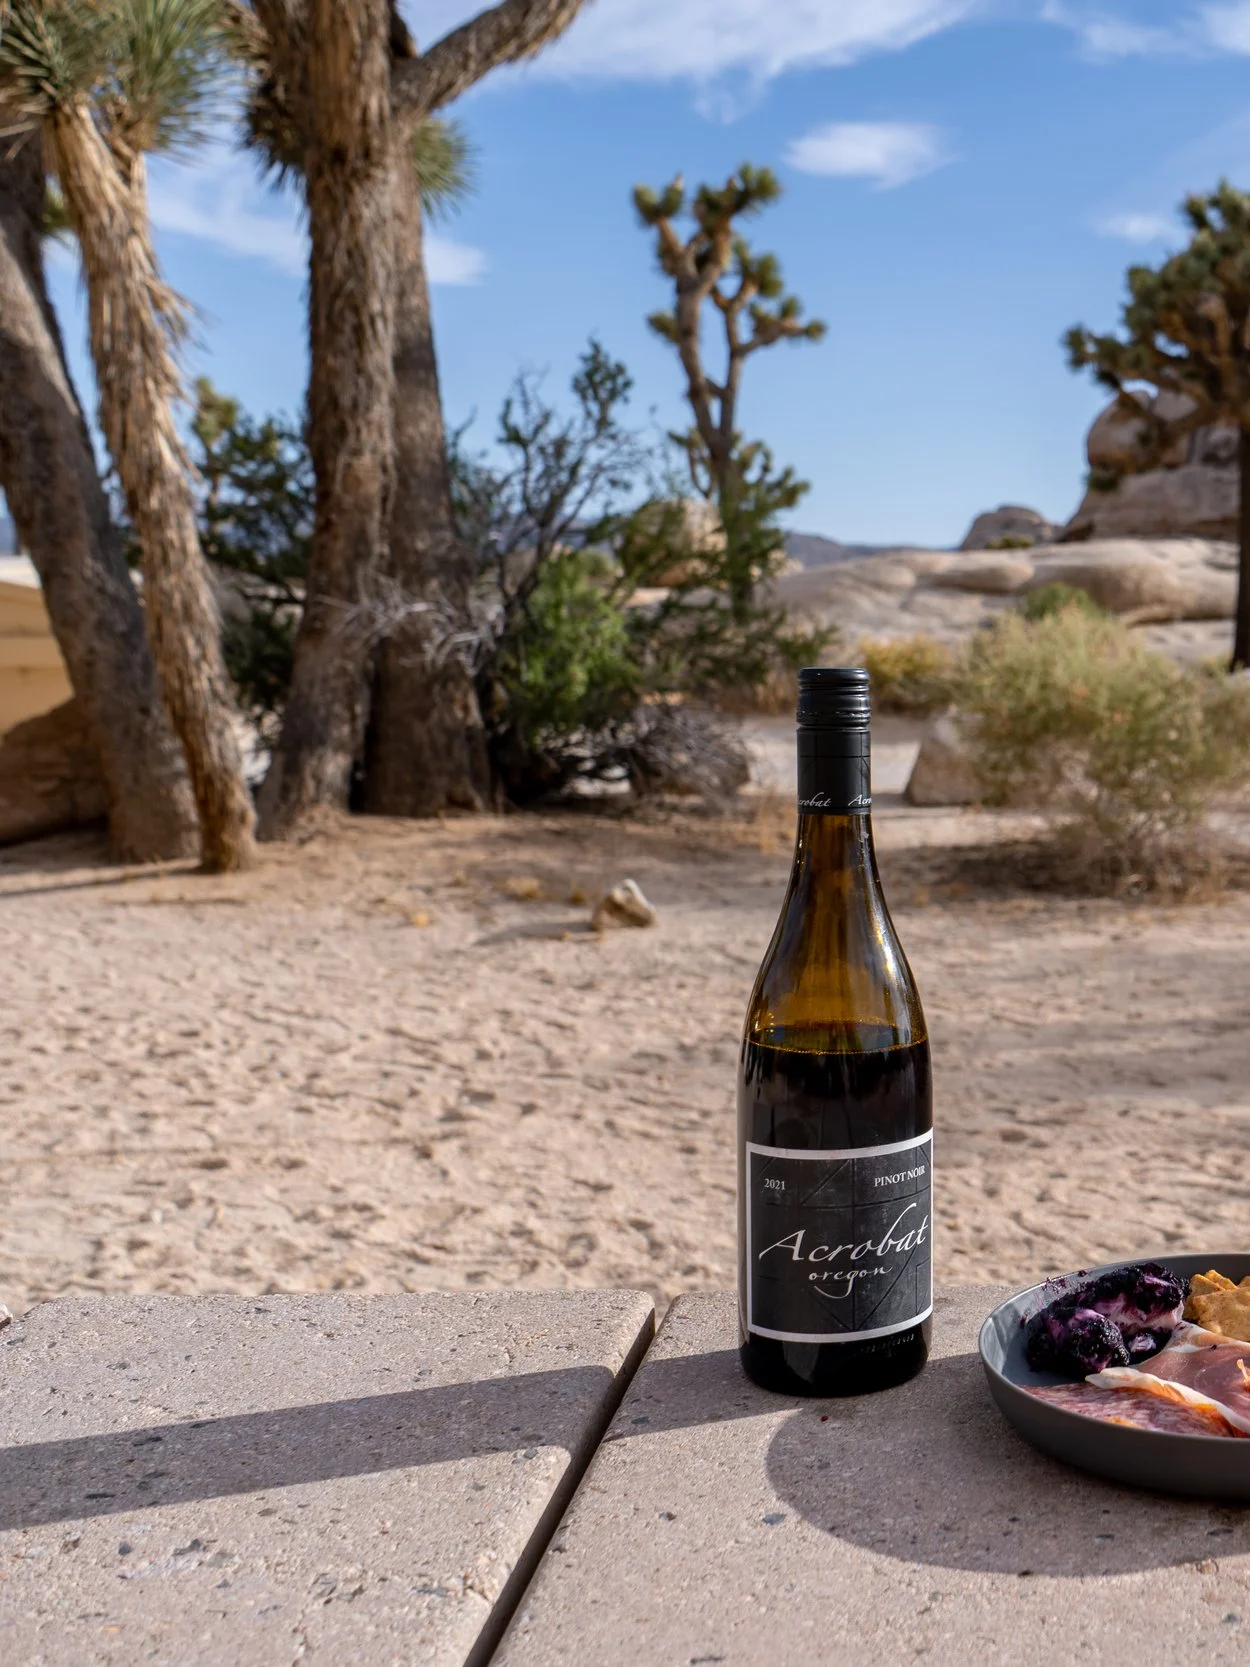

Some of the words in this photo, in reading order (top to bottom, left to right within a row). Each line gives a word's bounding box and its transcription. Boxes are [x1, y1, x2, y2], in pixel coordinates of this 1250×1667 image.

[764, 1178, 786, 1190] 2021
[874, 1172, 906, 1187] PINOT
[907, 1165, 925, 1180] NOIR
[758, 1202, 929, 1262] Acrobat
[808, 1265, 893, 1299] oregon
